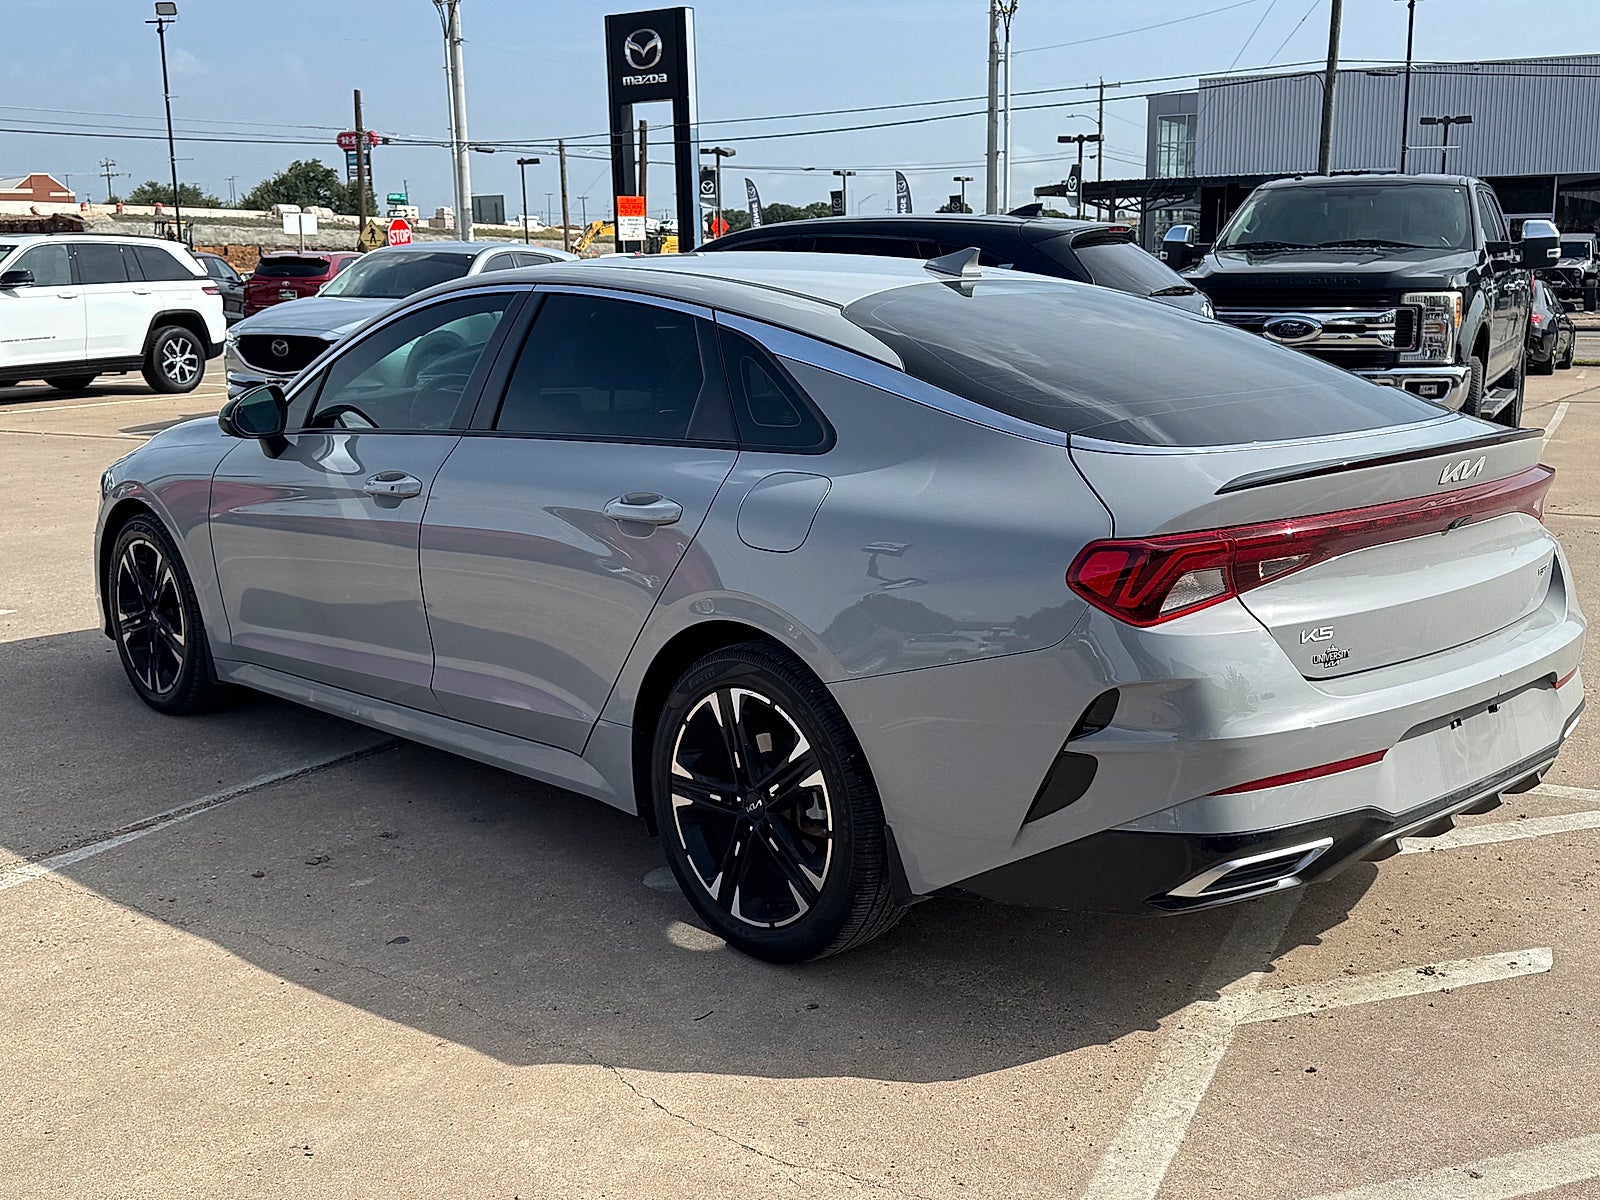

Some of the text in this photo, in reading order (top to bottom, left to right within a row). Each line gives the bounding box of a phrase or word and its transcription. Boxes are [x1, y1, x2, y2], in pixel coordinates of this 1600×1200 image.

[622, 73, 668, 86] mazda
[391, 229, 410, 244] STOP
[1279, 322, 1307, 335] Ford
[1299, 625, 1334, 644] K5
[1312, 648, 1352, 665] UNIVERSITY
